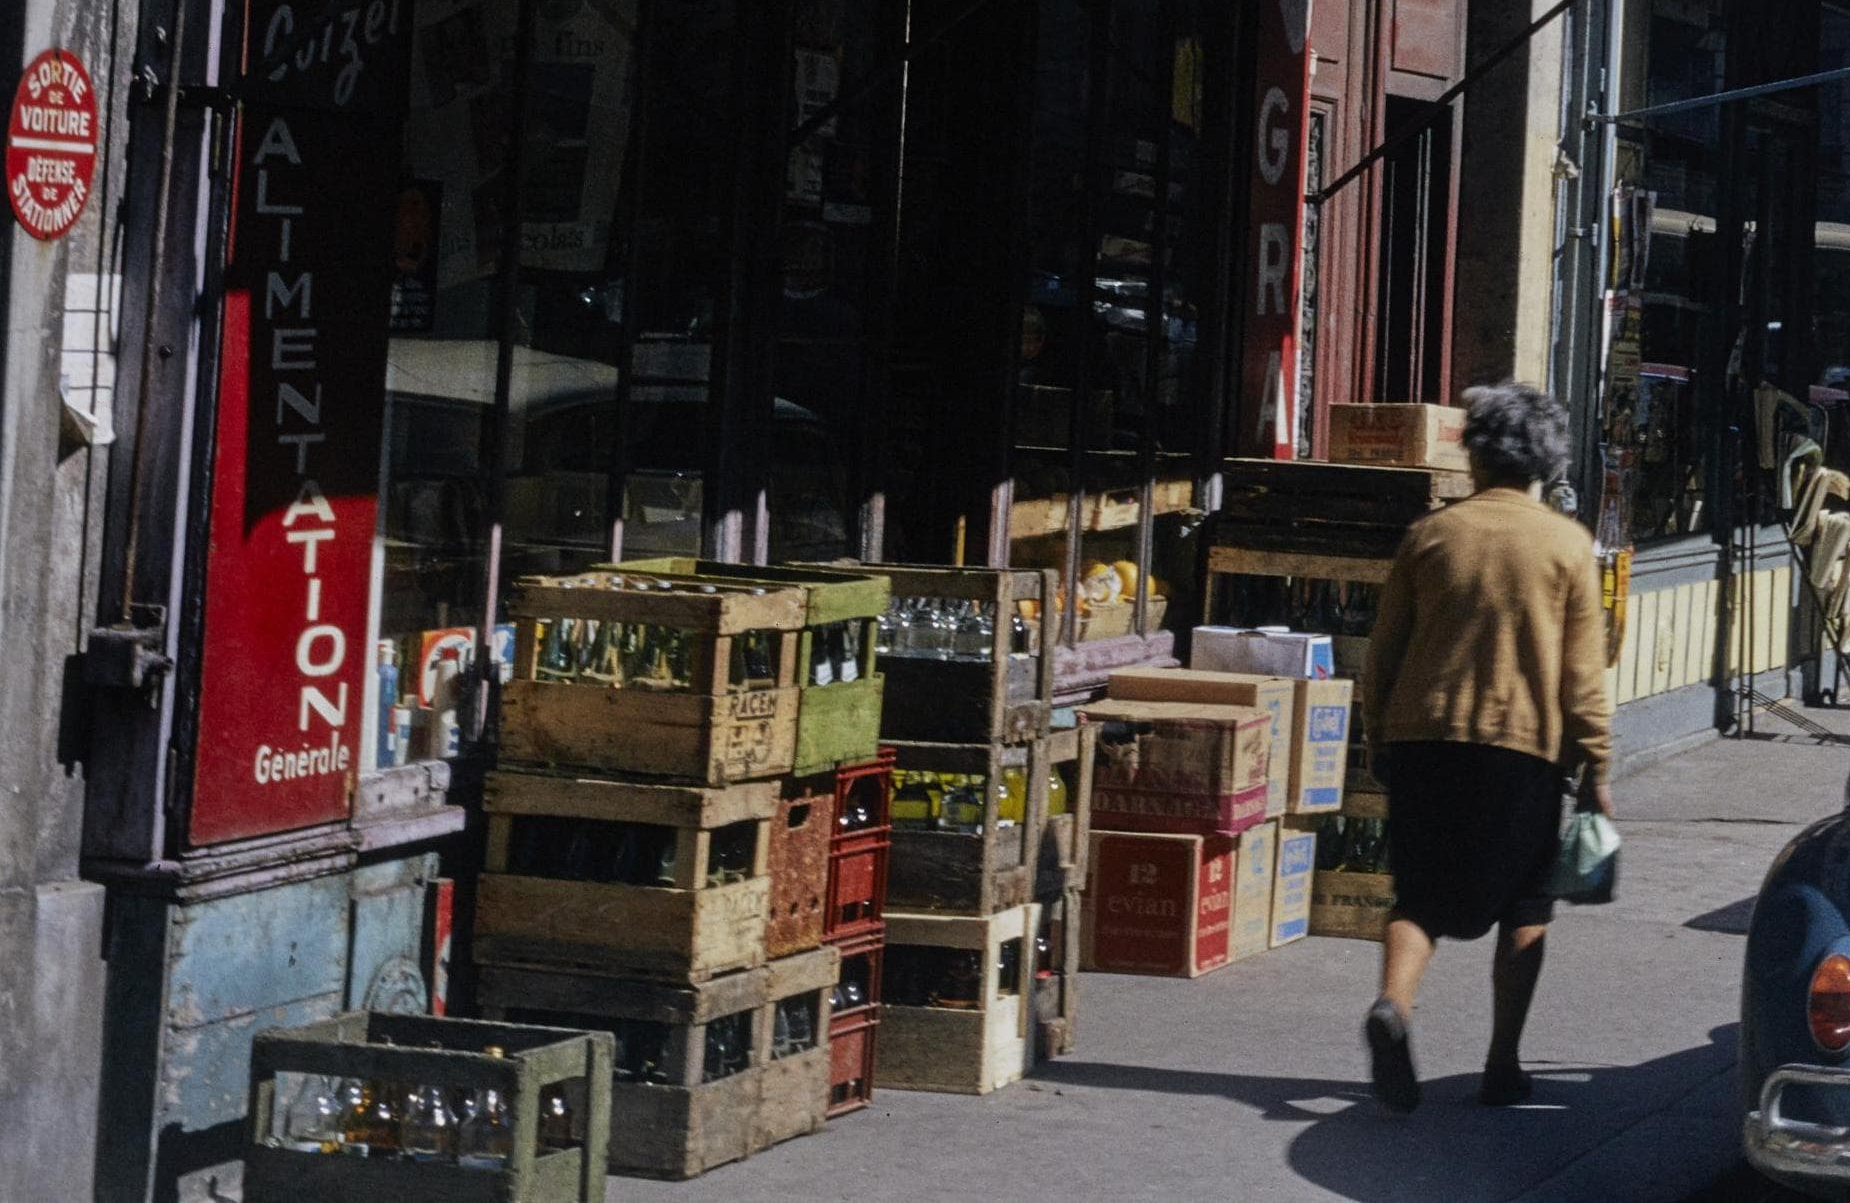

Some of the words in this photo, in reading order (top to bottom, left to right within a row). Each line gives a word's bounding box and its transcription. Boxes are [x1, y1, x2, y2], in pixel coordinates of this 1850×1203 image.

[28, 60, 87, 104] SORTIE
[49, 91, 64, 105] DE
[20, 105, 91, 137] VOITURE
[13, 174, 86, 232] STATIONNER
[42, 187, 58, 201] DE
[254, 117, 347, 732] ALIMENTATION
[1107, 890, 1177, 918] evian
